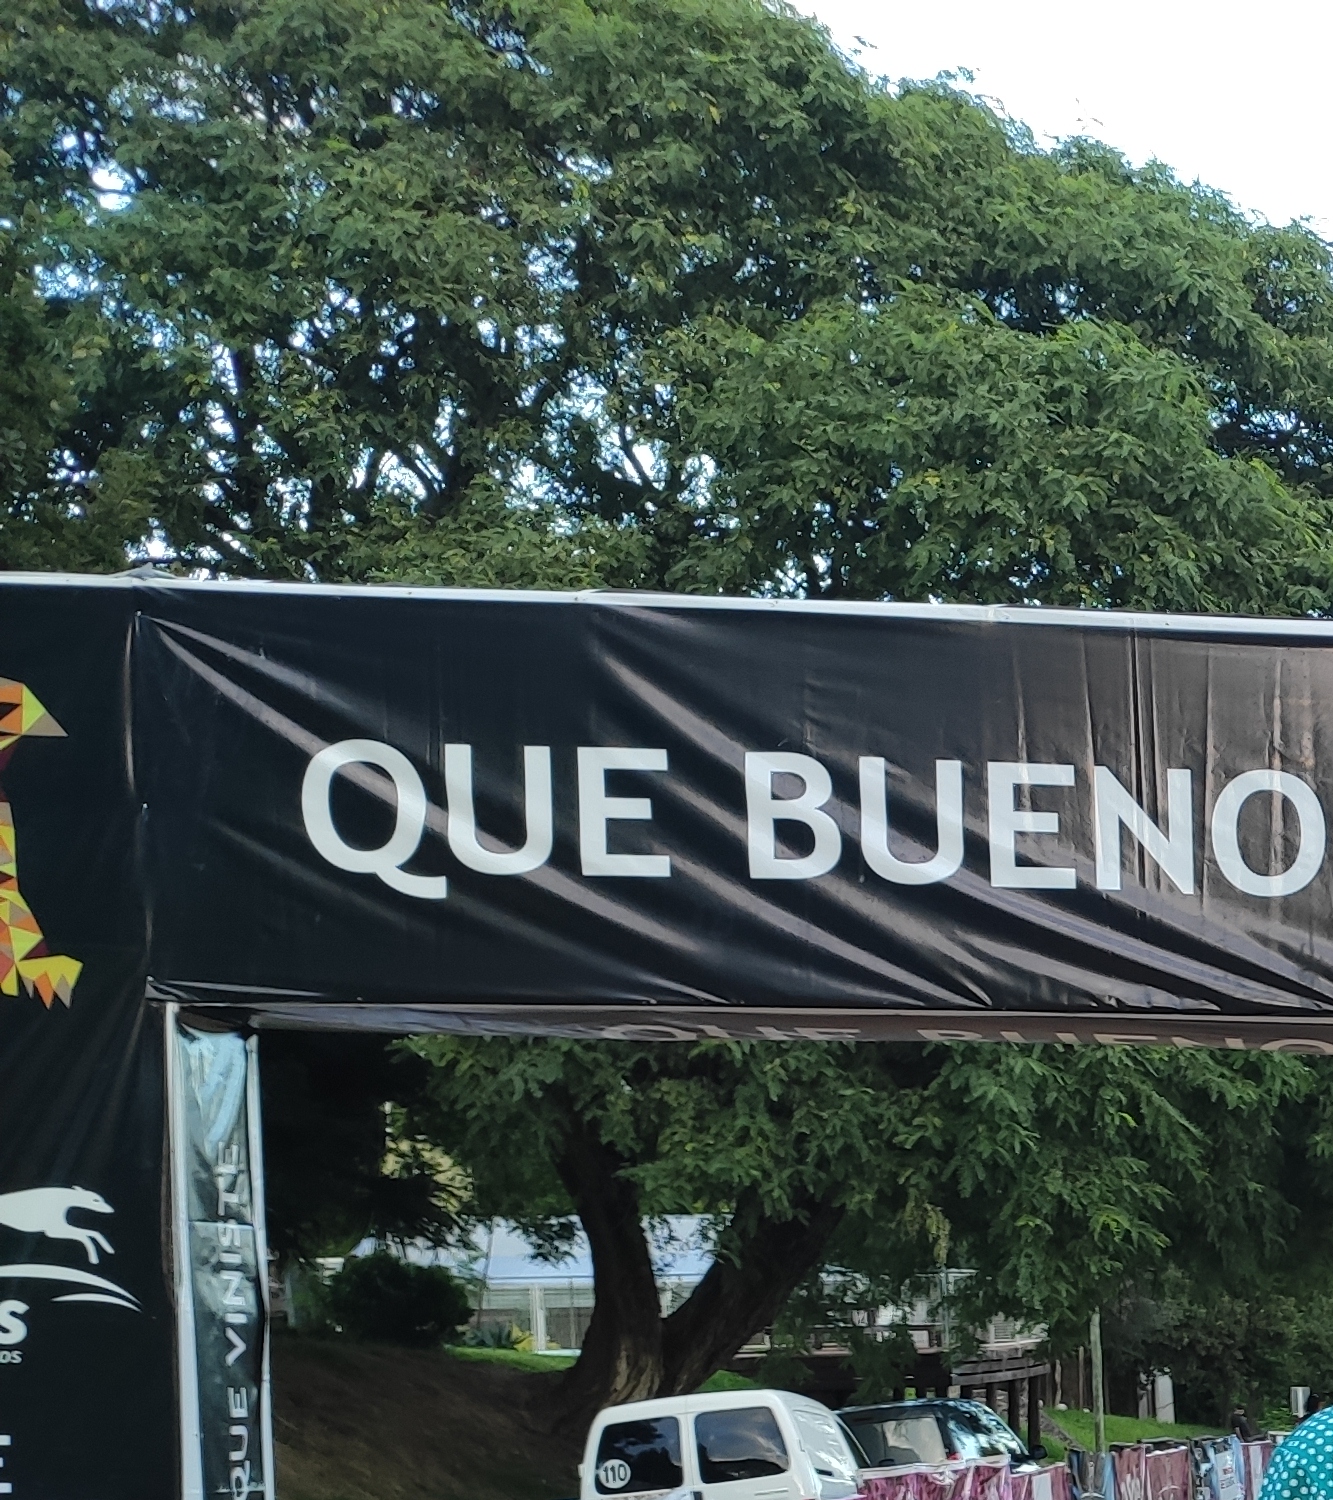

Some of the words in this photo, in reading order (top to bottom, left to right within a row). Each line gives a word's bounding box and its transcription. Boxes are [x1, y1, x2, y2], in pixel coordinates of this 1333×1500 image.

[301, 738, 672, 900] QUE
[743, 751, 1327, 898] BUENO
[213, 1140, 248, 1367] VINISTE
[603, 1463, 627, 1484] 110
